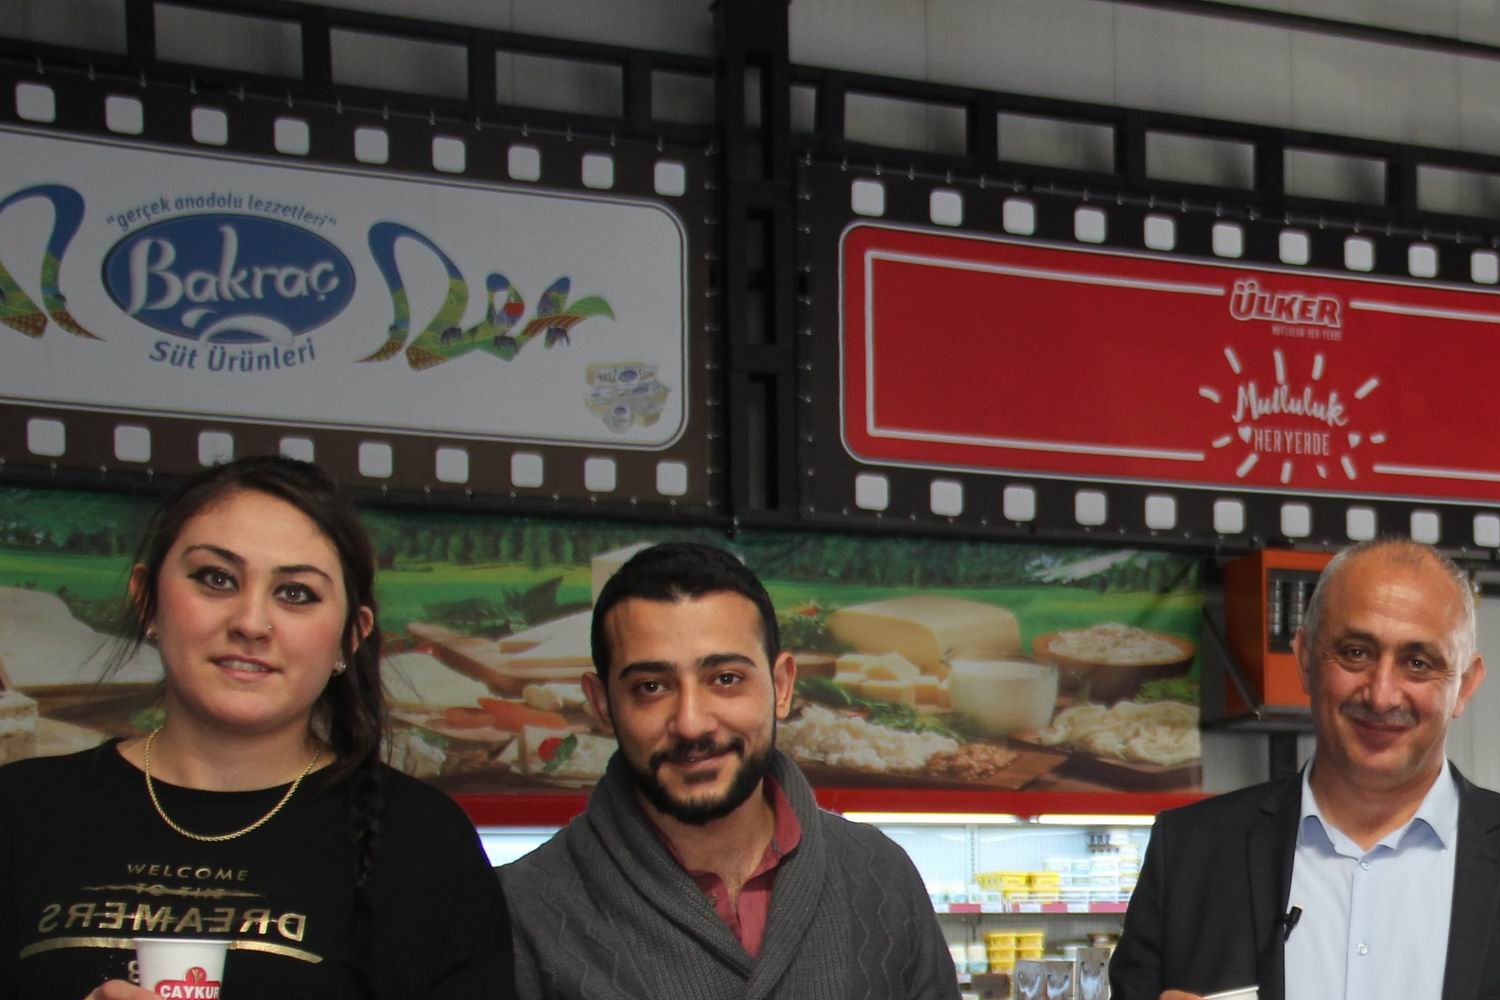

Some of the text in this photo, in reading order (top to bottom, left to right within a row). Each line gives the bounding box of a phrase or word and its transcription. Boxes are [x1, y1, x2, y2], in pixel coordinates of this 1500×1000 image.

[175, 192, 242, 210] anadolu
[124, 225, 340, 315] Bakraç
[1230, 281, 1342, 328] ÜLKER
[149, 337, 316, 372] Süt Ürünleri
[1232, 381, 1348, 427] Mutluluk
[1254, 428, 1330, 456] HER YERDE
[127, 864, 249, 881] WELCOME
